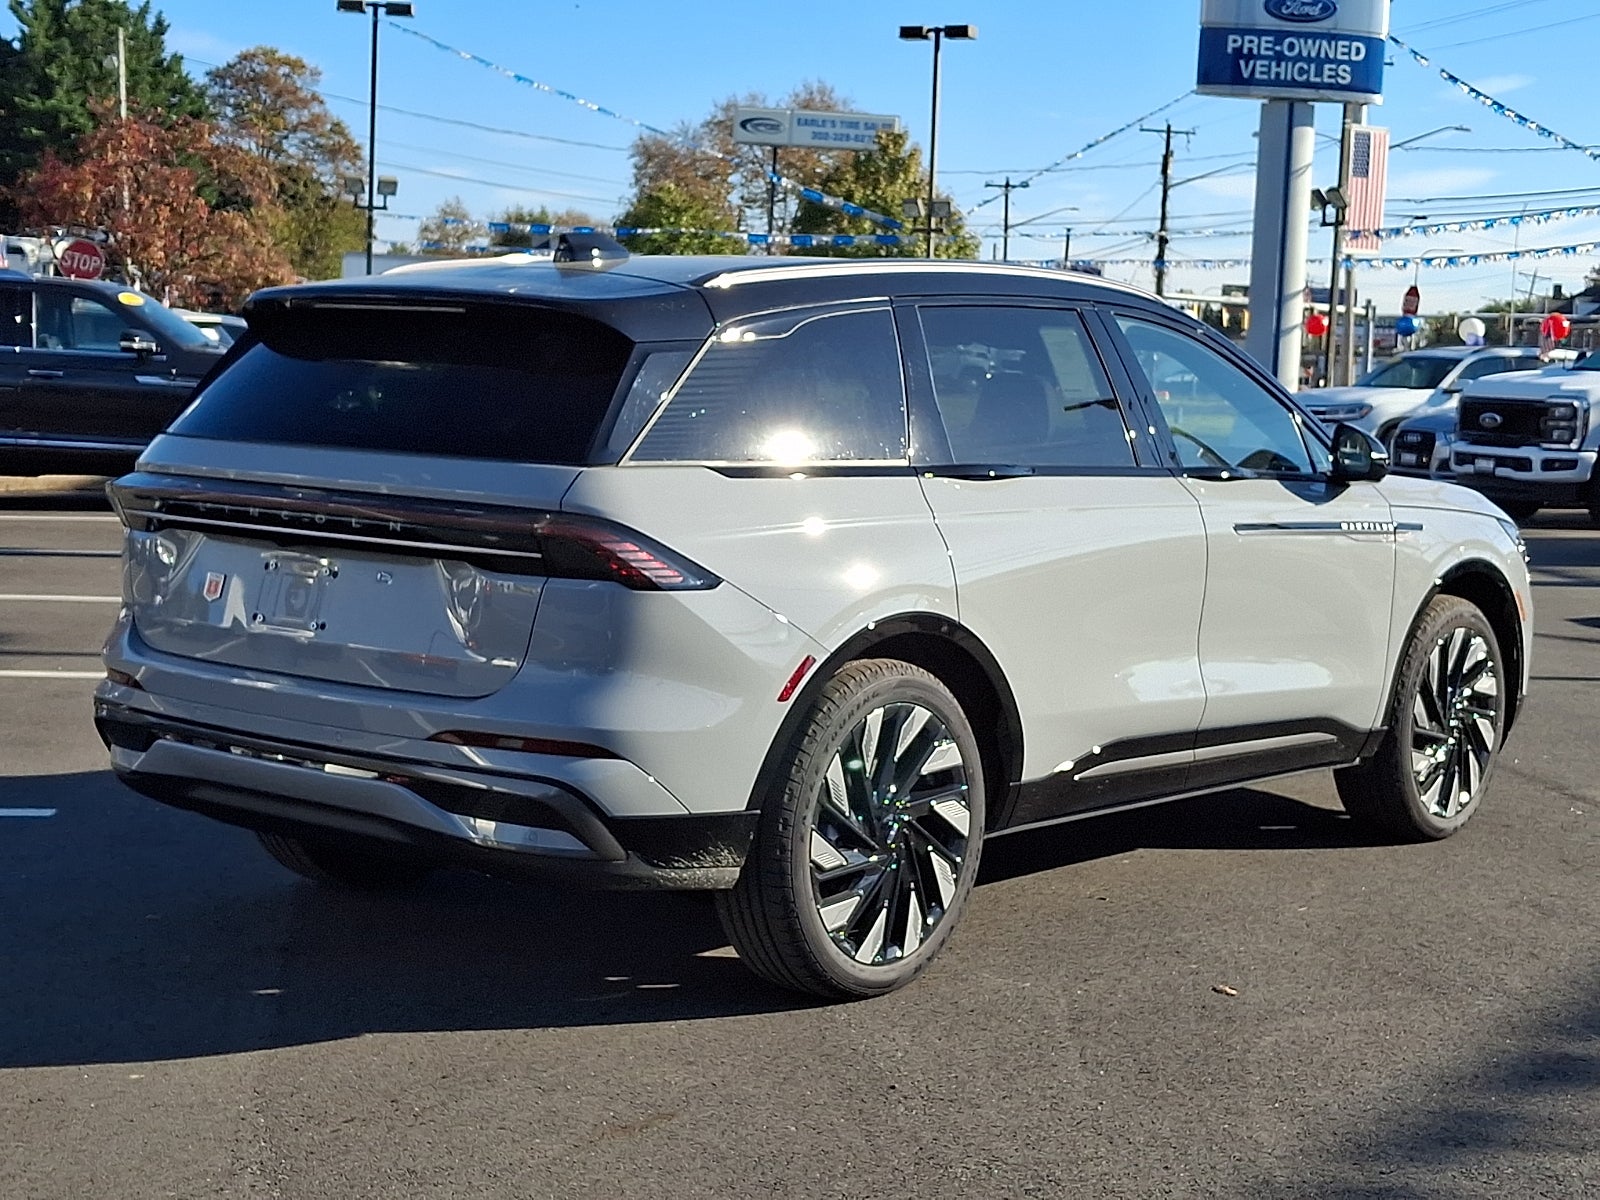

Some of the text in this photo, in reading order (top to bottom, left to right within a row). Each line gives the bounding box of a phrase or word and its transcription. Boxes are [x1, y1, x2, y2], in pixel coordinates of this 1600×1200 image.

[1281, 0, 1322, 16] Ford
[1227, 34, 1366, 61] PRE-OWNED
[1239, 59, 1352, 84] VEHICLES
[61, 252, 100, 271] STOP
[199, 502, 402, 532] LINCOLN
